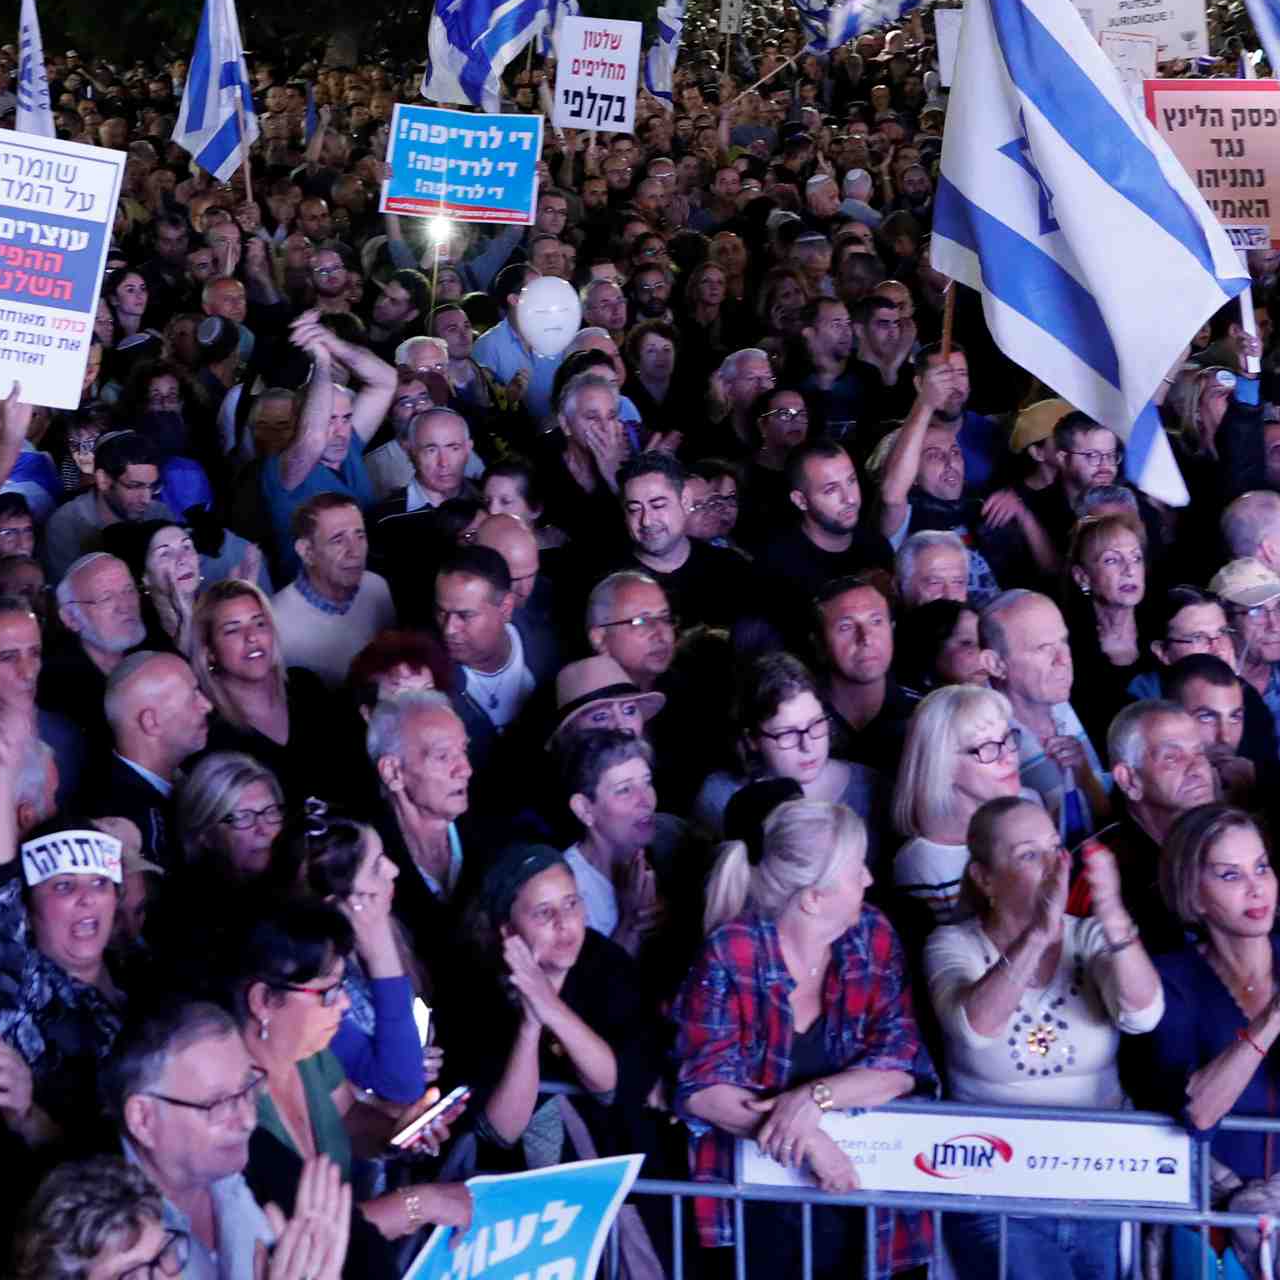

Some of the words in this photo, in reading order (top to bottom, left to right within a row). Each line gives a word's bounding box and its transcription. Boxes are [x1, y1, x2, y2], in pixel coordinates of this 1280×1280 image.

[583, 29, 623, 50] שלטון
[571, 58, 626, 80] מחליפים
[563, 86, 626, 126] בקלפי
[1162, 105, 1224, 131] הלינץ
[399, 118, 505, 149] לרדיפה!
[509, 131, 534, 150] די
[1210, 138, 1245, 158] נגד
[408, 151, 494, 176] לרדיפה!
[496, 161, 519, 177] די
[1196, 168, 1265, 188] נתניהו
[64, 187, 95, 212] על
[415, 178, 486, 200] לרדיפה!
[487, 186, 505, 200] די
[13, 330, 53, 347] טובת
[57, 337, 81, 351] את
[932, 1144, 997, 1170] אורתן
[1026, 1155, 1149, 1172] 077-7767127
